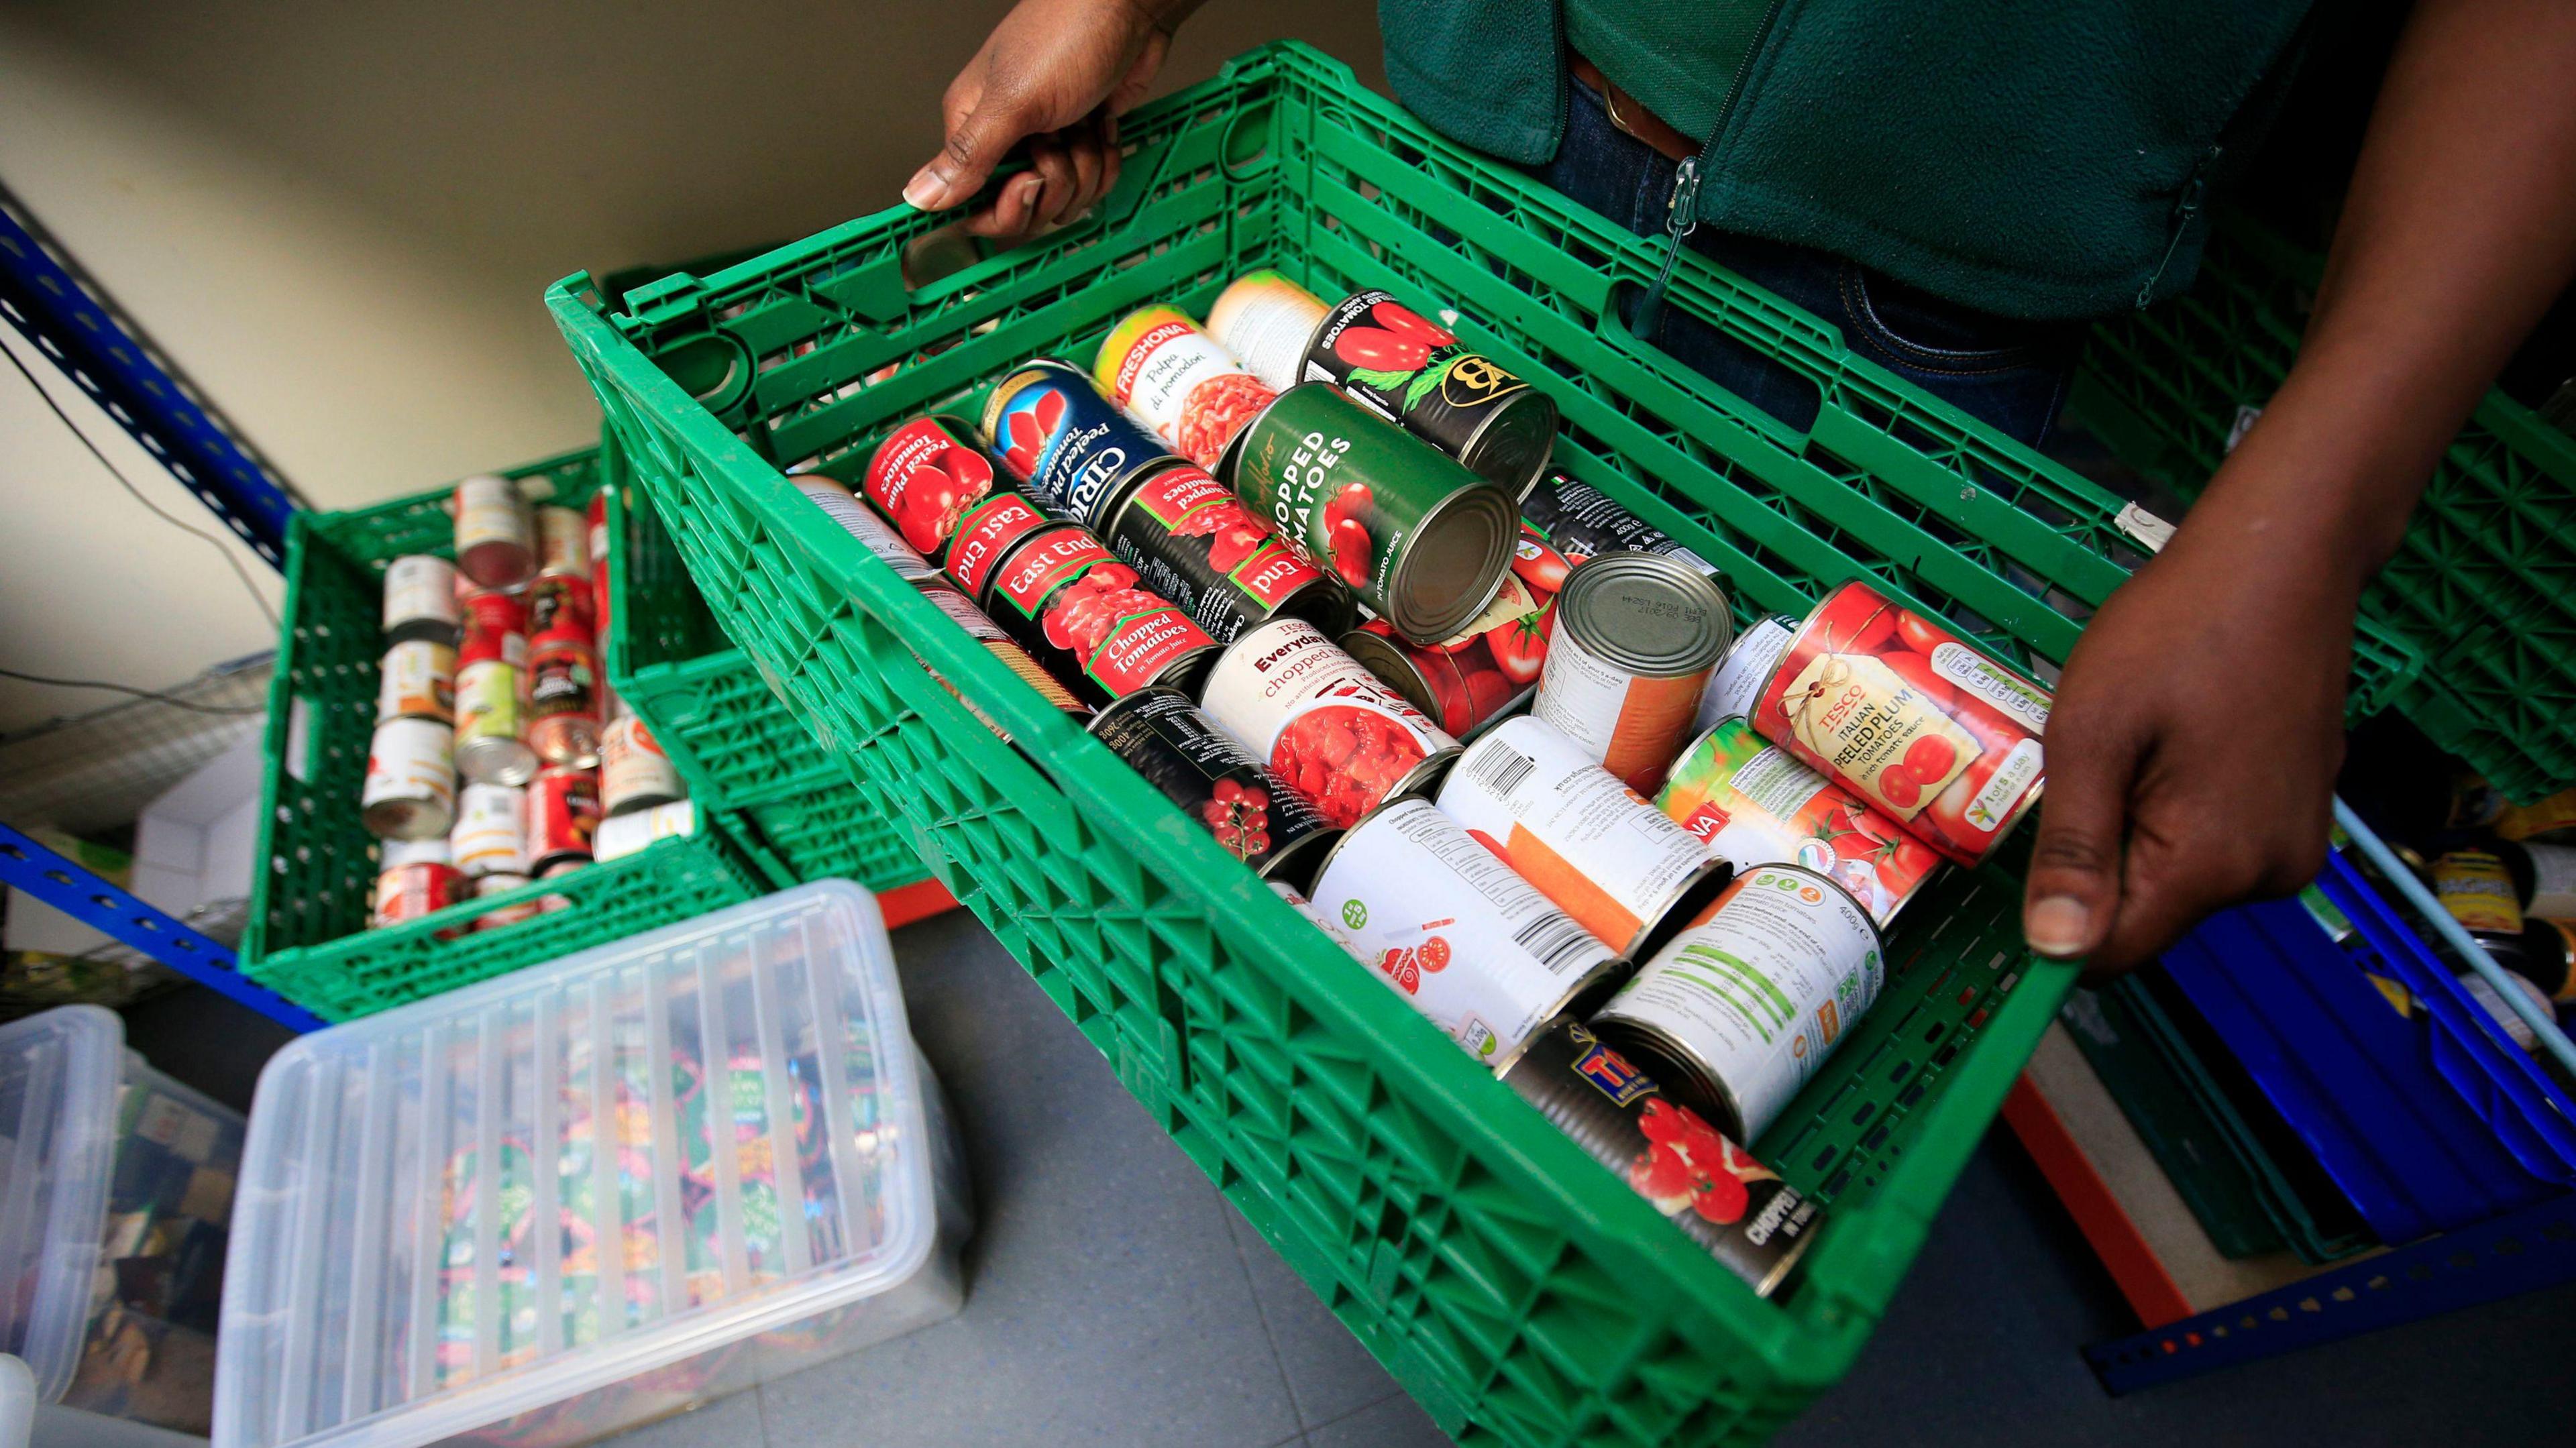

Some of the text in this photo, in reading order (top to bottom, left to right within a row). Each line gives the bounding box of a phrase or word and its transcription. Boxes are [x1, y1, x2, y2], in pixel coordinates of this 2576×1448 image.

[1341, 296, 1360, 313] JUICE
[1322, 302, 1366, 349] TOMATOES
[1117, 323, 1181, 388] FRESHONA
[1145, 348, 1180, 383] Polpa
[1148, 349, 1205, 409] di pomodori
[1061, 421, 1109, 471] Peeled
[878, 434, 931, 493] Tomatoes
[884, 437, 947, 508] Peeled Plum
[1163, 477, 1217, 502] omatoes
[1617, 522, 1634, 535] 400g
[959, 506, 1030, 585] East End
[1376, 557, 1389, 590] TOMATO
[1386, 531, 1401, 556] JUICE
[1010, 551, 1055, 594] East
[1055, 535, 1095, 555] End
[1252, 563, 1297, 593] End
[1639, 606, 1677, 618] 09/2017
[1107, 612, 1170, 659] Chopped
[1114, 622, 1186, 673] Tomatoes
[1136, 636, 1187, 673] in Tomato Juice
[1256, 634, 1321, 671] Everyday
[1265, 650, 1328, 696] chopped
[1301, 663, 1330, 682] Produced
[1587, 663, 1601, 674] your
[1740, 665, 1748, 675] can
[1285, 677, 1320, 709] No artificial
[1743, 677, 1756, 694] Organic
[1118, 713, 1134, 726] Drained
[1819, 683, 1862, 728] TESCO
[1098, 721, 1119, 740] 260g
[1835, 689, 1911, 768] PEELED PLUM
[1838, 703, 1874, 741] ITALIAN
[1109, 731, 1130, 750] 400g
[1131, 736, 1144, 749] Before
[1859, 718, 1902, 764] TOMATOES
[1860, 715, 1924, 781] in rich tomato sauce
[1466, 771, 1503, 801] 0112 5214
[1560, 783, 1574, 797] more?
[1985, 752, 2029, 803] 1 of 5 a day
[1998, 789, 2010, 802] half
[2008, 781, 2017, 790] of
[2019, 765, 2031, 778] can
[1563, 793, 1580, 808] London
[1389, 812, 1408, 824] Chopped
[1578, 815, 1589, 826] 0800
[1688, 817, 1719, 836] NA
[1656, 877, 1668, 889] your
[1352, 903, 1364, 914] 5
[1765, 893, 1817, 924] plum tomatoes
[1838, 905, 1861, 929] 400g
[1787, 922, 1798, 931] see
[1798, 929, 1811, 940] end
[1809, 938, 1817, 946] of
